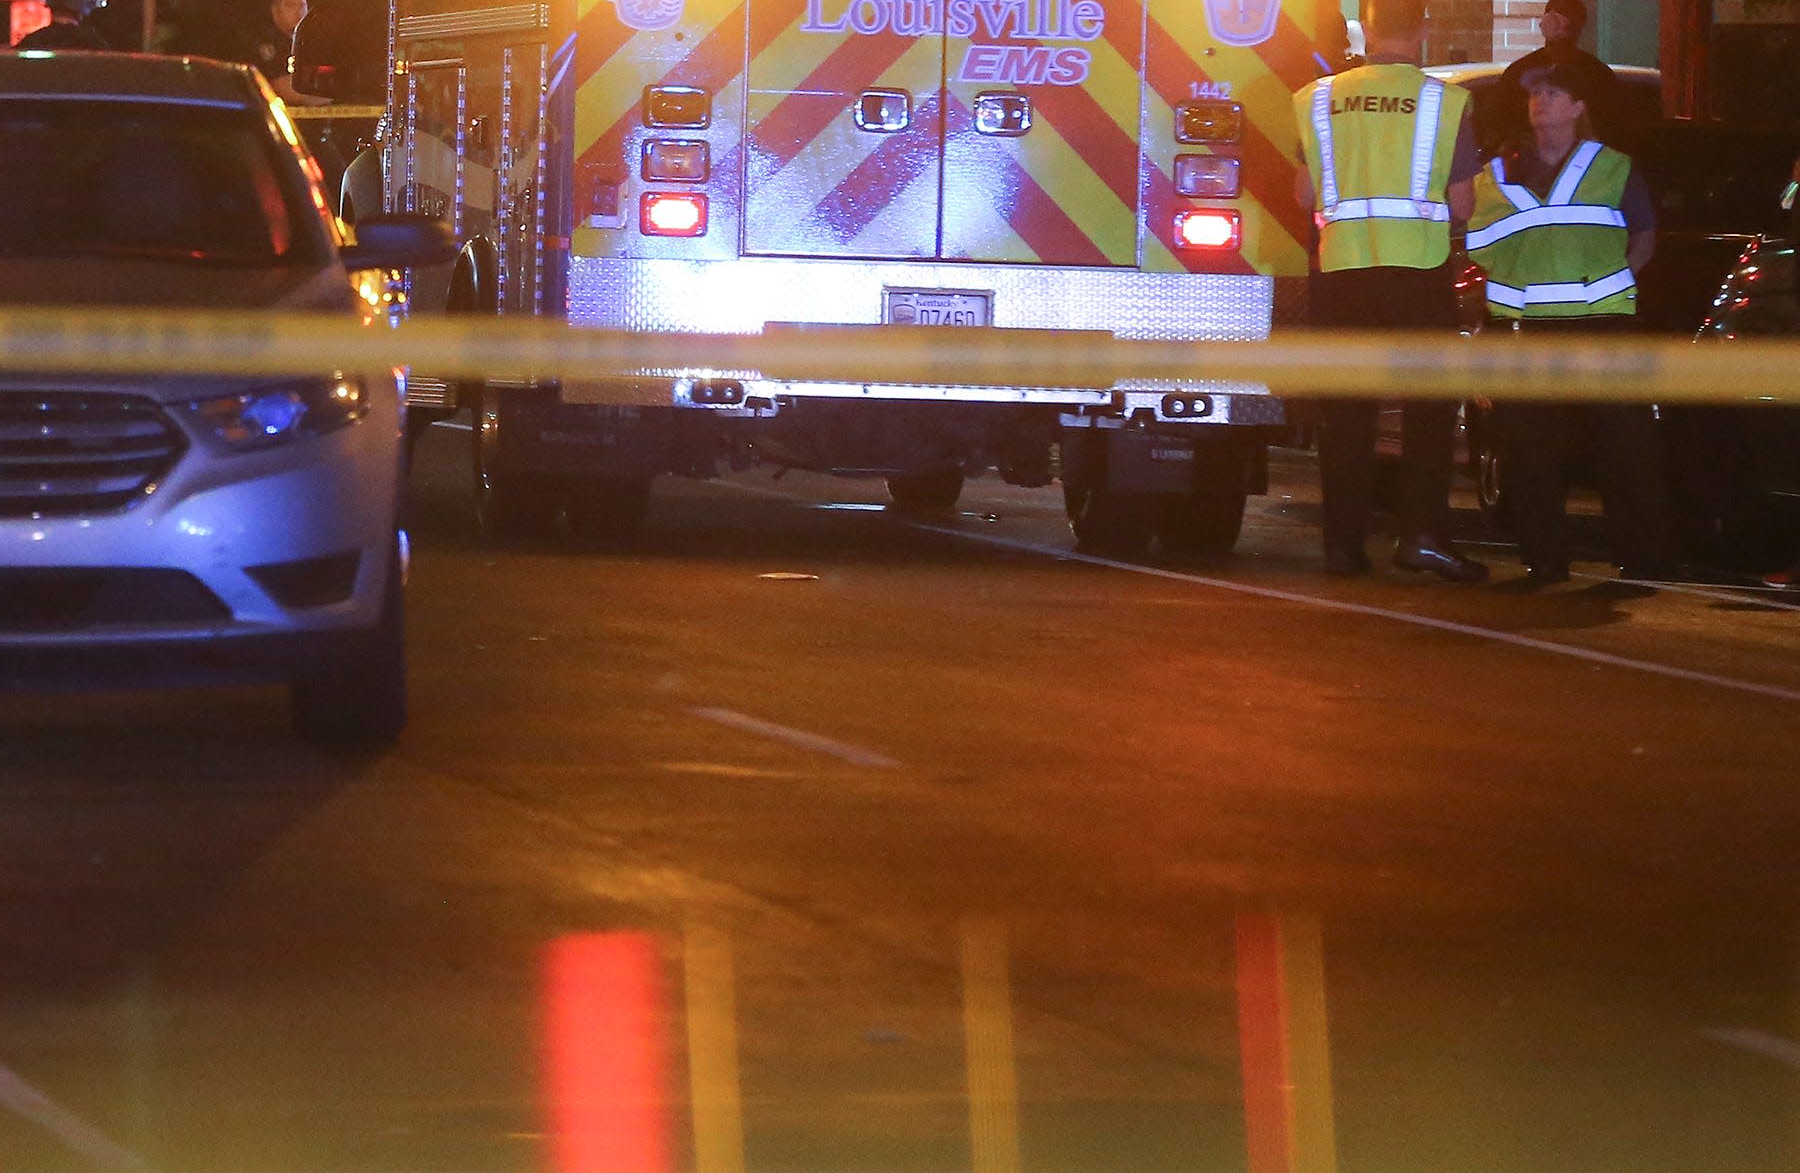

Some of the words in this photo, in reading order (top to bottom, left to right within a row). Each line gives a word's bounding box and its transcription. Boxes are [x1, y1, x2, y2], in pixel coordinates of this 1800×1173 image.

[960, 44, 1091, 87] EMS
[1189, 81, 1232, 100] 1442
[1331, 95, 1417, 115] LMEMS
